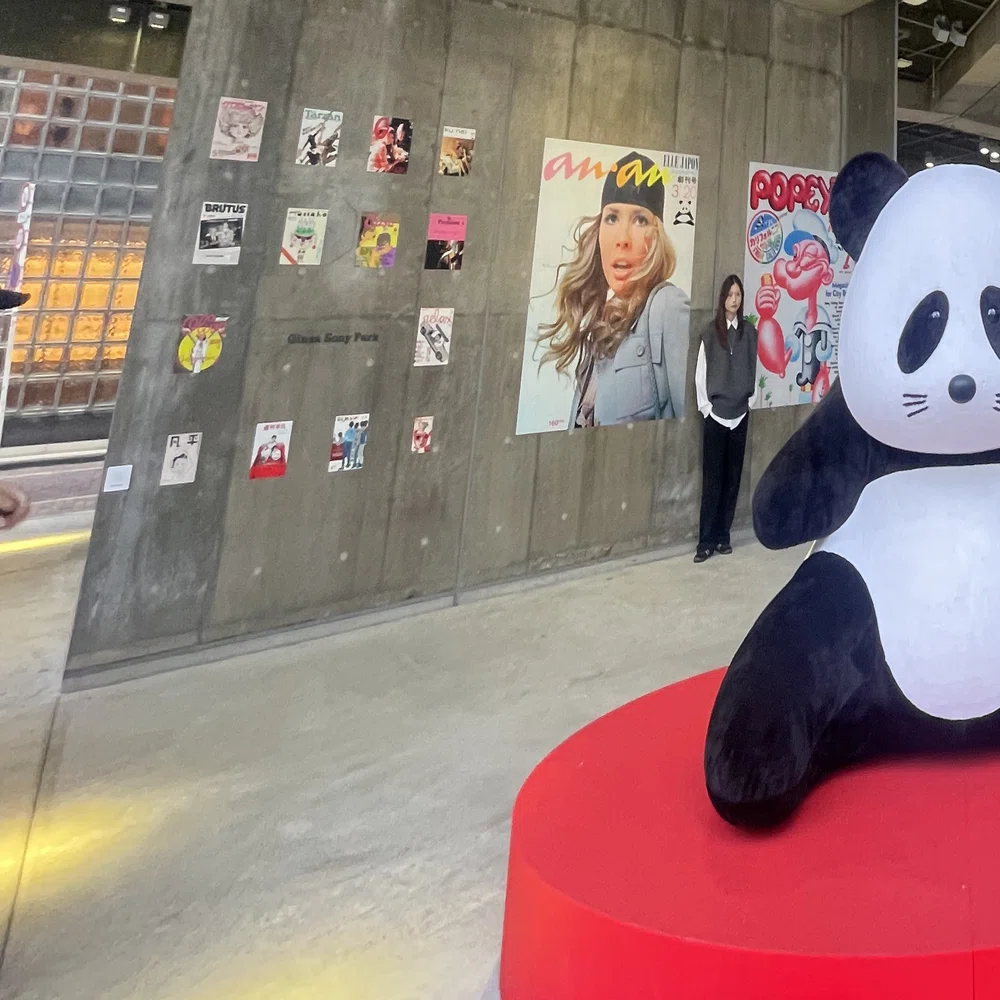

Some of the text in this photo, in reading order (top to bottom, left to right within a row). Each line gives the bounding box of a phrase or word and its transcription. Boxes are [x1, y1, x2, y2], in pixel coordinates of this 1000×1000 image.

[750, 170, 836, 215] POPEY
[205, 203, 246, 214] BRUTUS
[324, 332, 352, 345] Sony
[353, 332, 379, 342] Park
